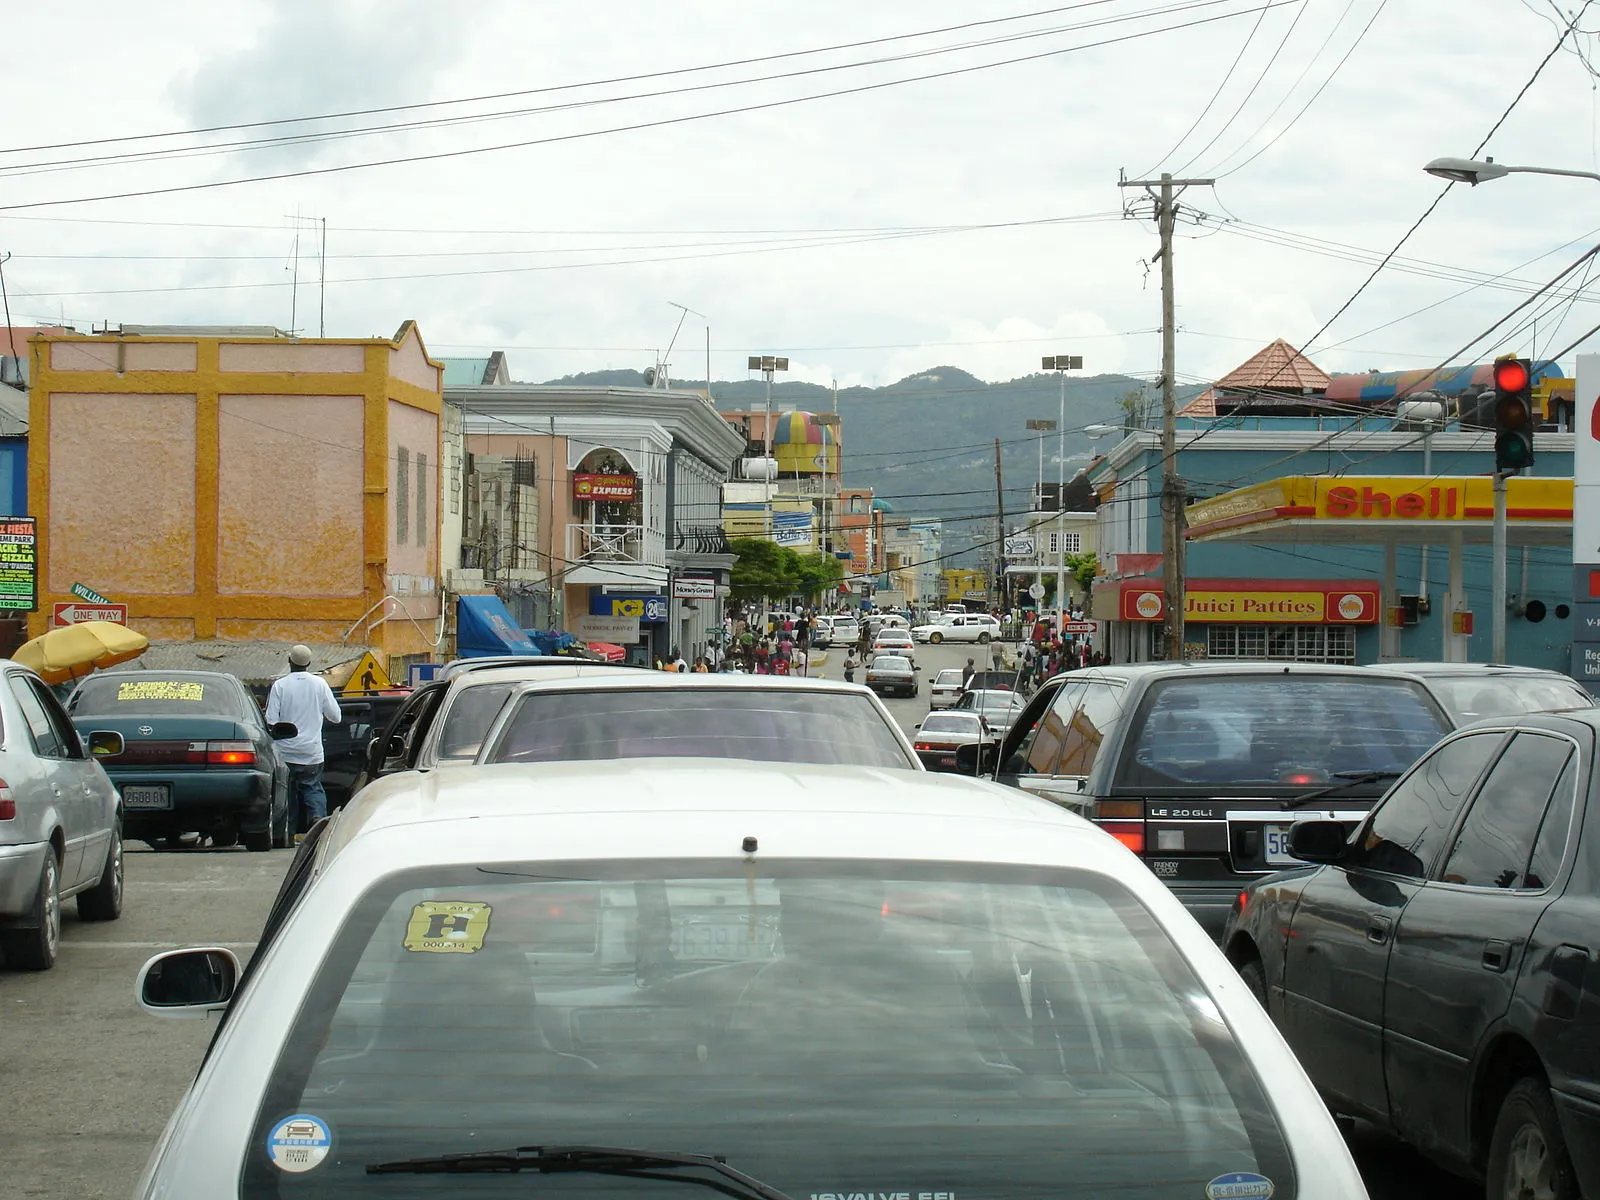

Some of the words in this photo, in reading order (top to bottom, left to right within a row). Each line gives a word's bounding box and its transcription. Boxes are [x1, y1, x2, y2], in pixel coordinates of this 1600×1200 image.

[592, 486, 633, 495] EXPRESS
[1327, 486, 1458, 517] Shell
[8, 523, 34, 535] FIESTA
[675, 586, 713, 594] MoneyGram
[1183, 598, 1235, 614] Juici
[1243, 599, 1316, 614] Patties
[73, 611, 93, 620] ONE
[98, 611, 119, 620] WAY
